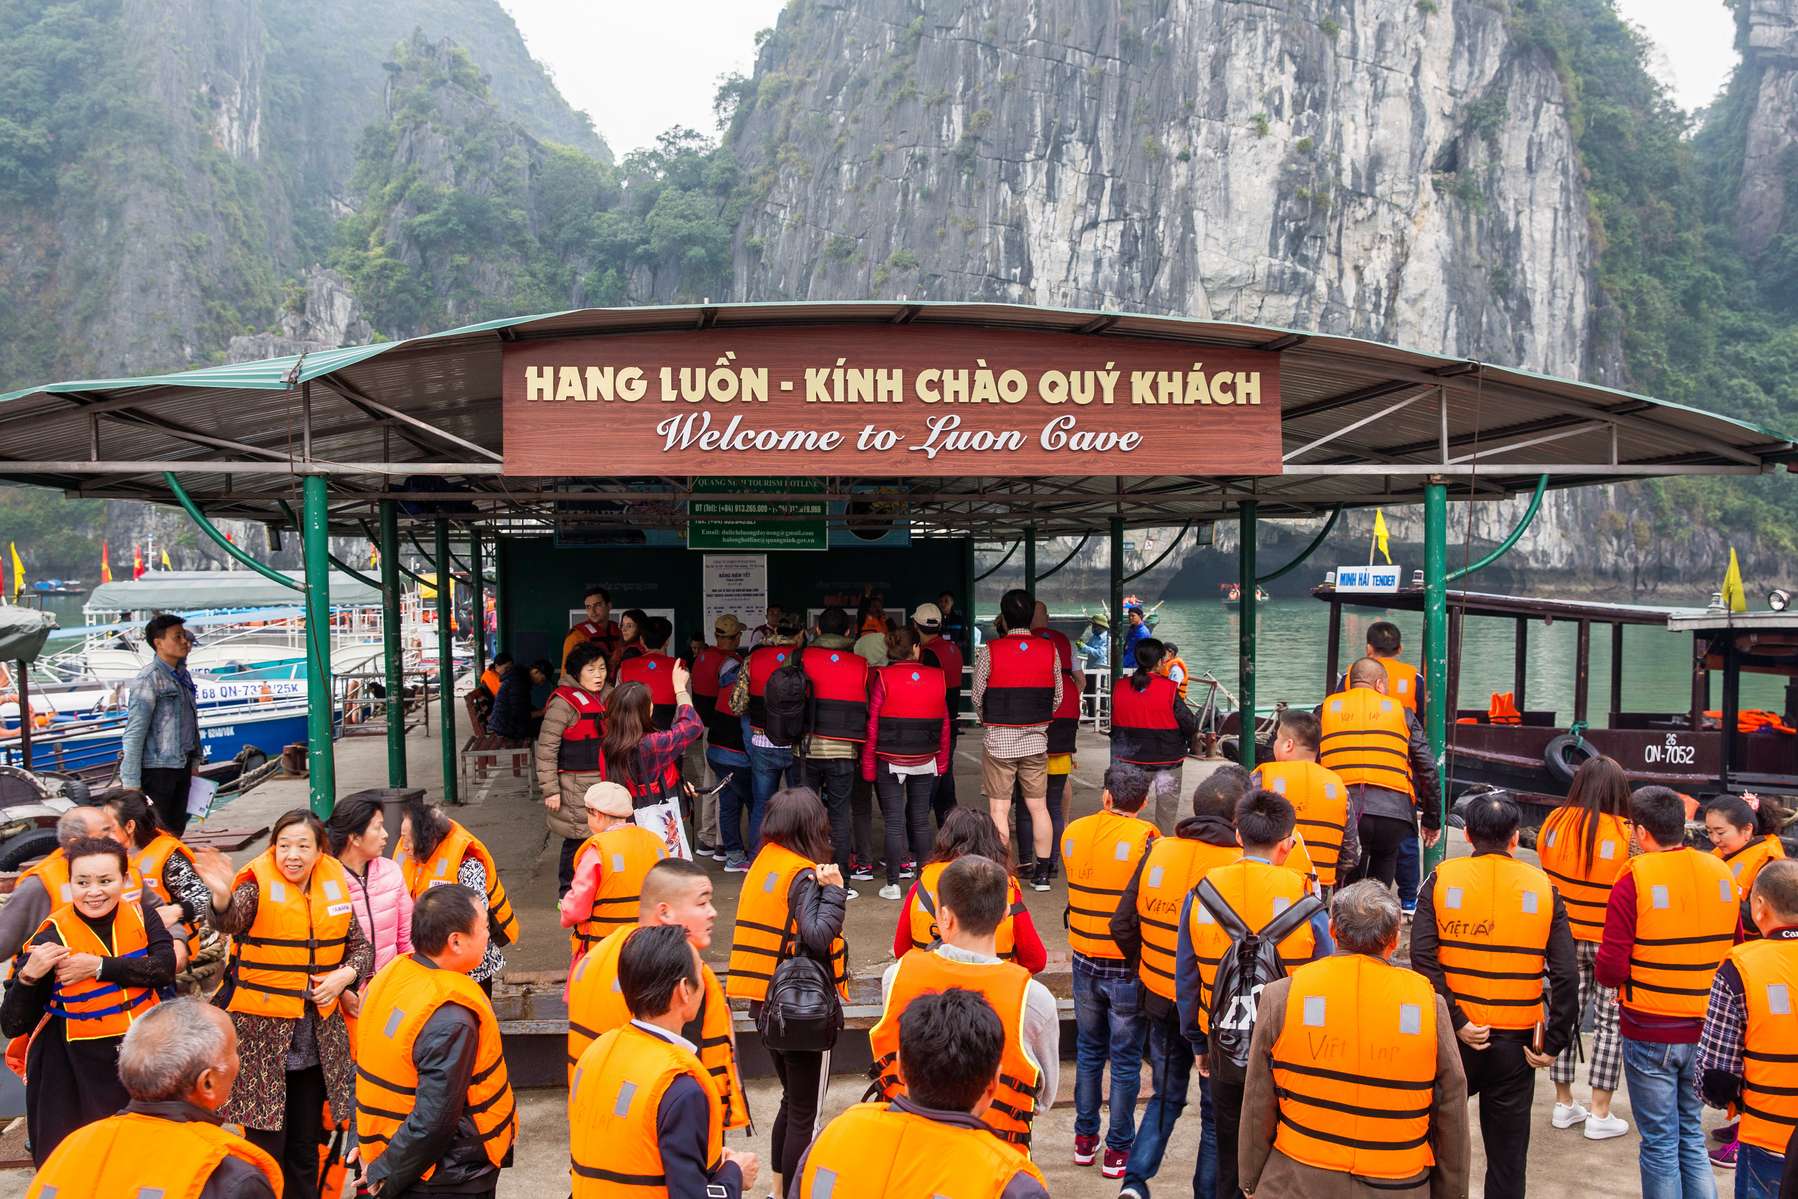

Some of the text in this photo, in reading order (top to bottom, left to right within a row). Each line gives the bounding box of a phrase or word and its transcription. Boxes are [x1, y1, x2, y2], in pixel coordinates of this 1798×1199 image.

[525, 351, 1261, 408] HANG LUỒN - KÍNH CHÀO QUÝ KHÁCH
[656, 411, 1143, 460] Welcome to Luon Cave
[1339, 572, 1357, 586] MINH
[1371, 575, 1396, 587] TENDER
[1665, 733, 1677, 746] 26
